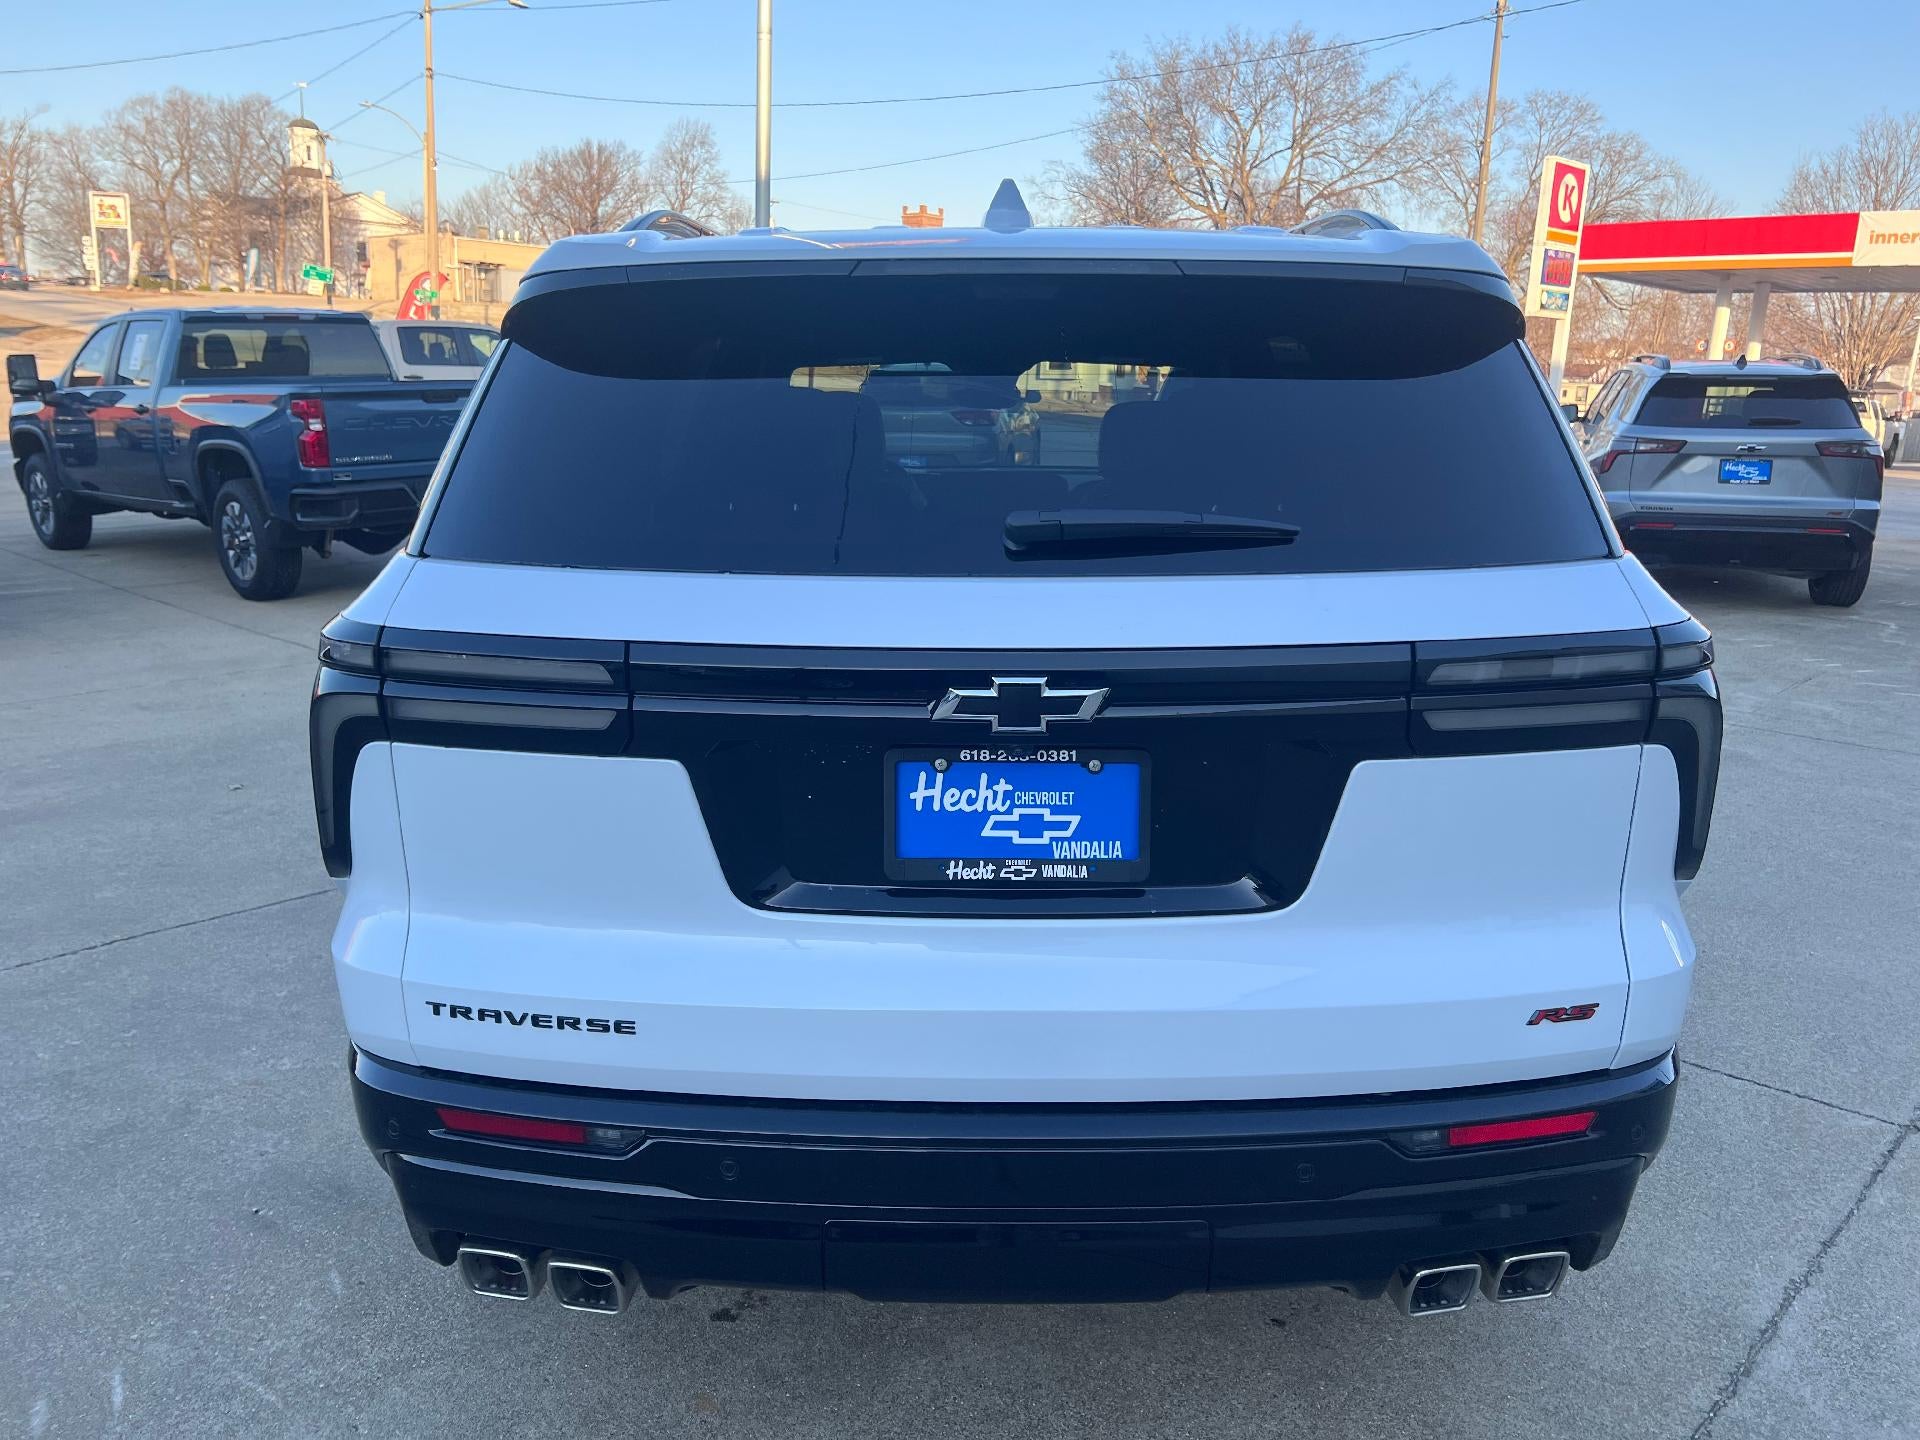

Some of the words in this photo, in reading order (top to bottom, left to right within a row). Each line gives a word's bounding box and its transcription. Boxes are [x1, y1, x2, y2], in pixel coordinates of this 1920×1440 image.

[910, 770, 1013, 813] Hecht
[1014, 791, 1075, 806] CHEVROLET
[1052, 840, 1123, 859] VANDALIA
[946, 860, 996, 880] Hecht
[1041, 864, 1088, 878] VANDALIA
[425, 1001, 637, 1035] TRAVERSE
[1525, 1003, 1600, 1025] RS
